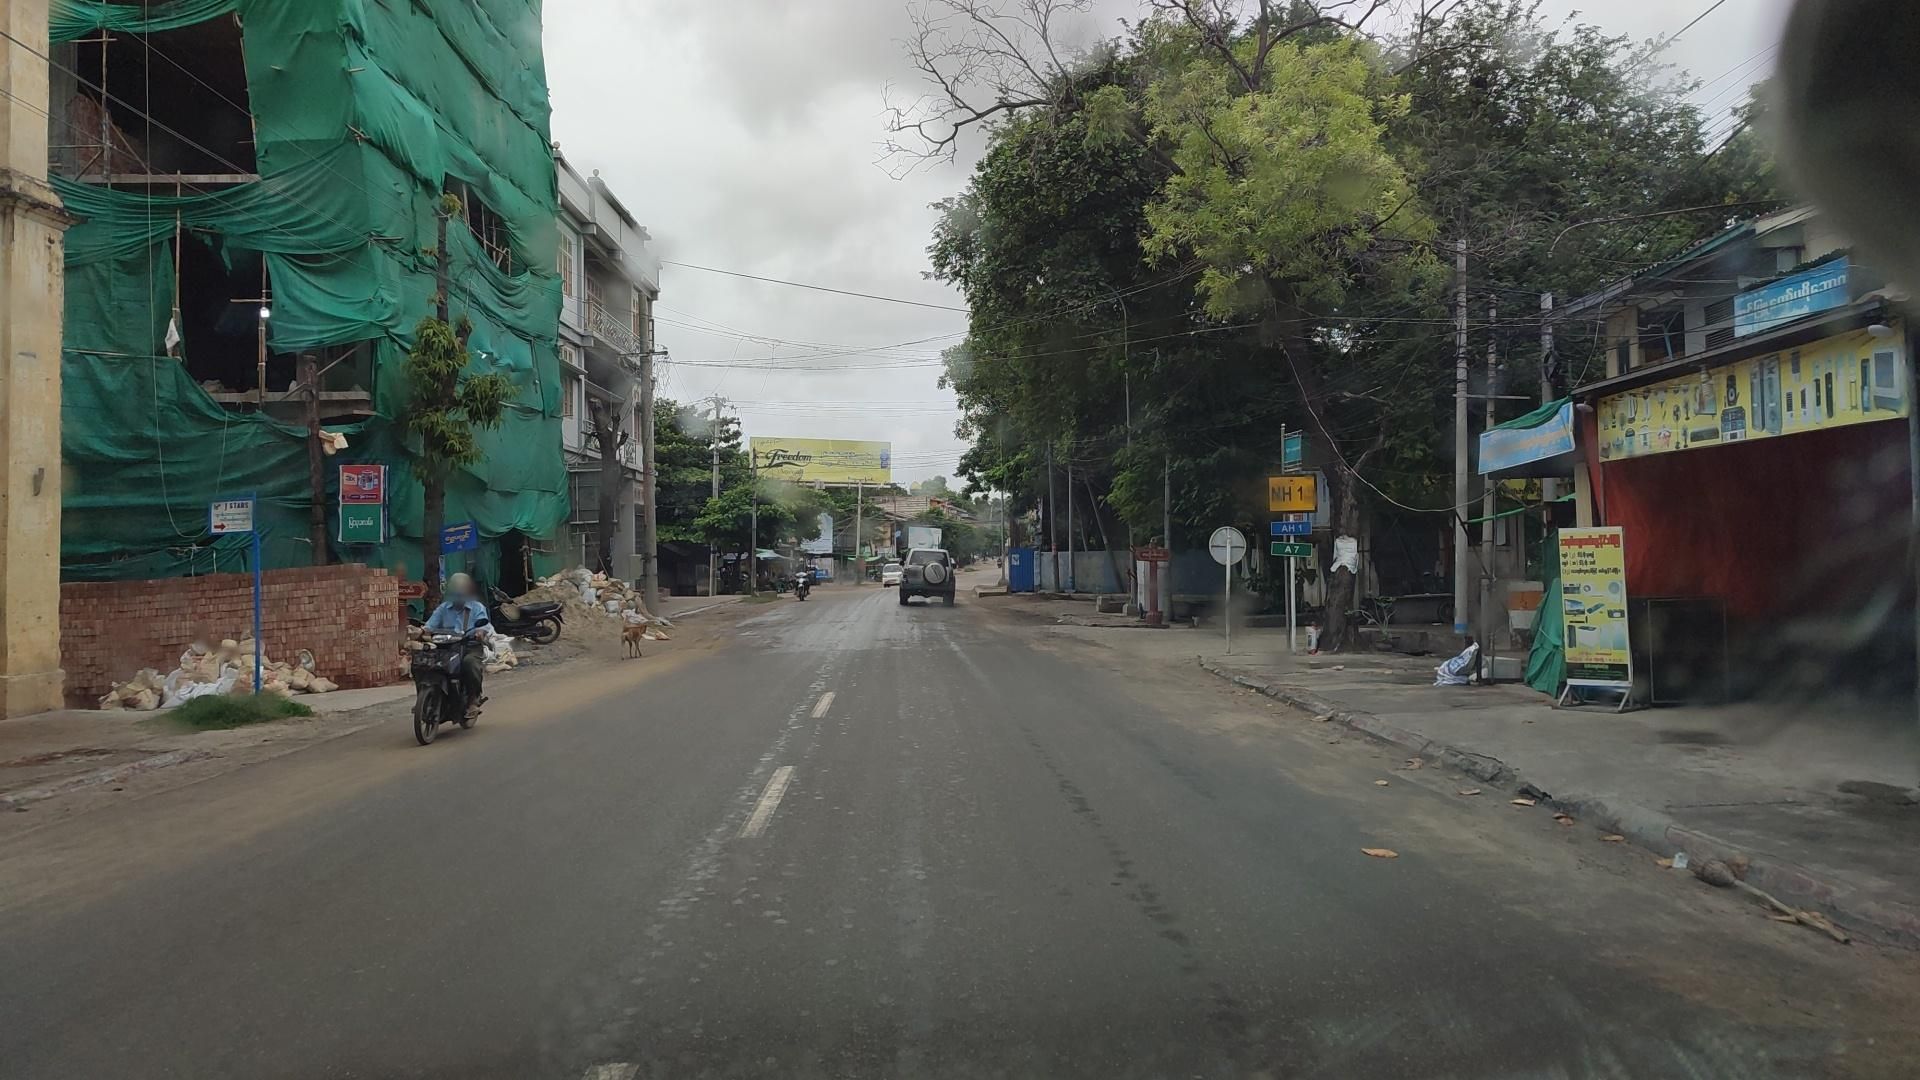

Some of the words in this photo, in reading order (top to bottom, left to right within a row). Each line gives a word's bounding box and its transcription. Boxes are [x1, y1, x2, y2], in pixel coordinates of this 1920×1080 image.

[766, 449, 812, 468] Freedom
[1271, 486, 1292, 502] NH
[1281, 524, 1295, 533] AH
[1284, 545, 1292, 553] A
